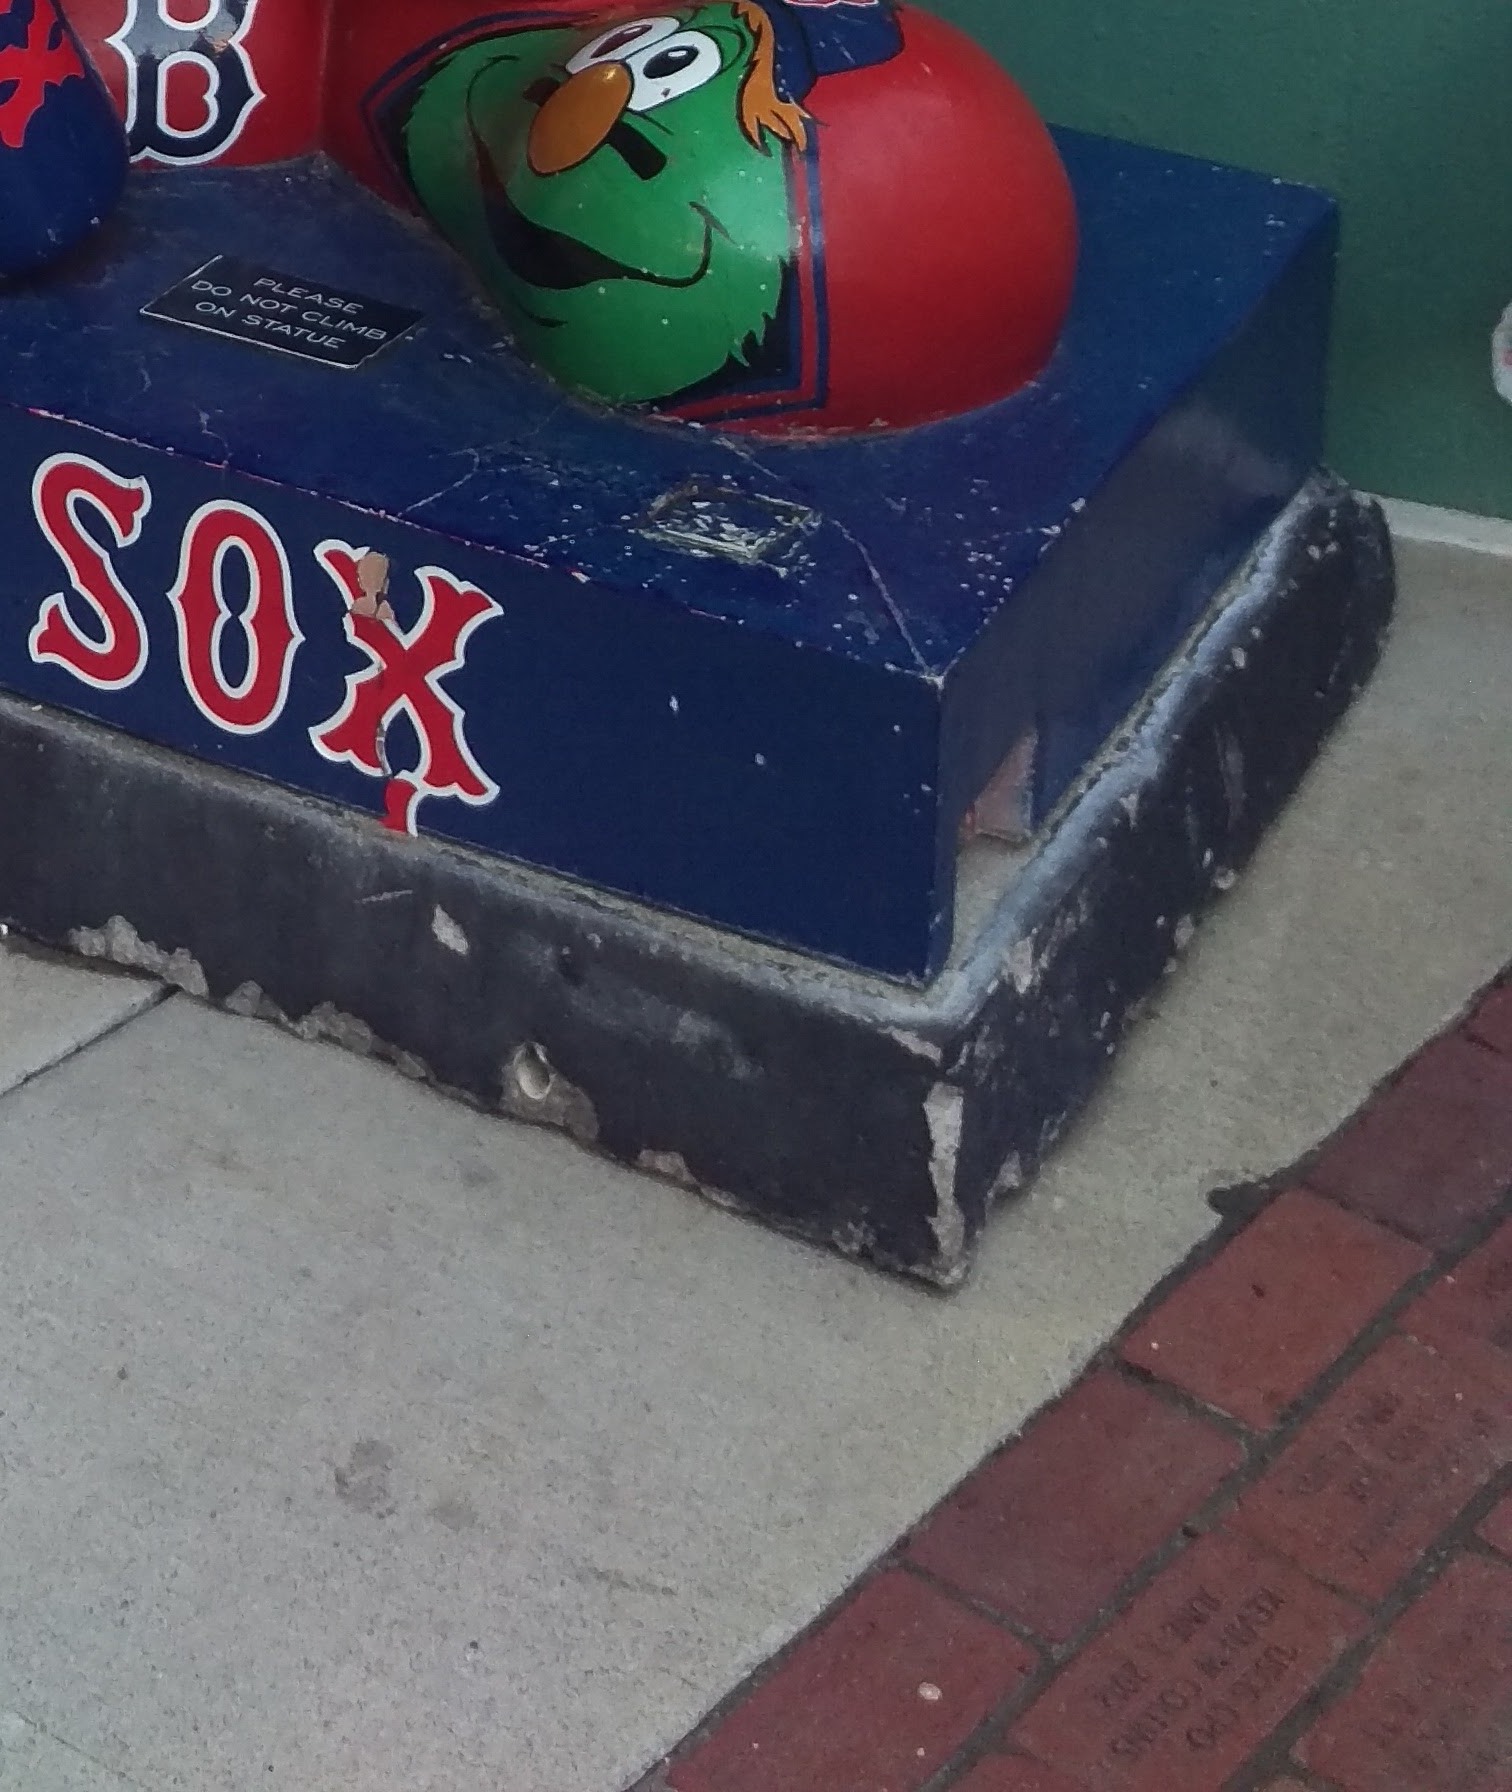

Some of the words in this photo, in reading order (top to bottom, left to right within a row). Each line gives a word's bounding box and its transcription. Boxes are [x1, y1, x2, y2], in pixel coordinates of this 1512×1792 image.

[191, 280, 233, 296] DO
[240, 293, 298, 313] NOT
[301, 311, 387, 340] CLIMB
[253, 277, 364, 314] PLEASE
[195, 301, 236, 318] ON
[241, 314, 346, 349] STATUE
[29, 452, 504, 836] SOX
